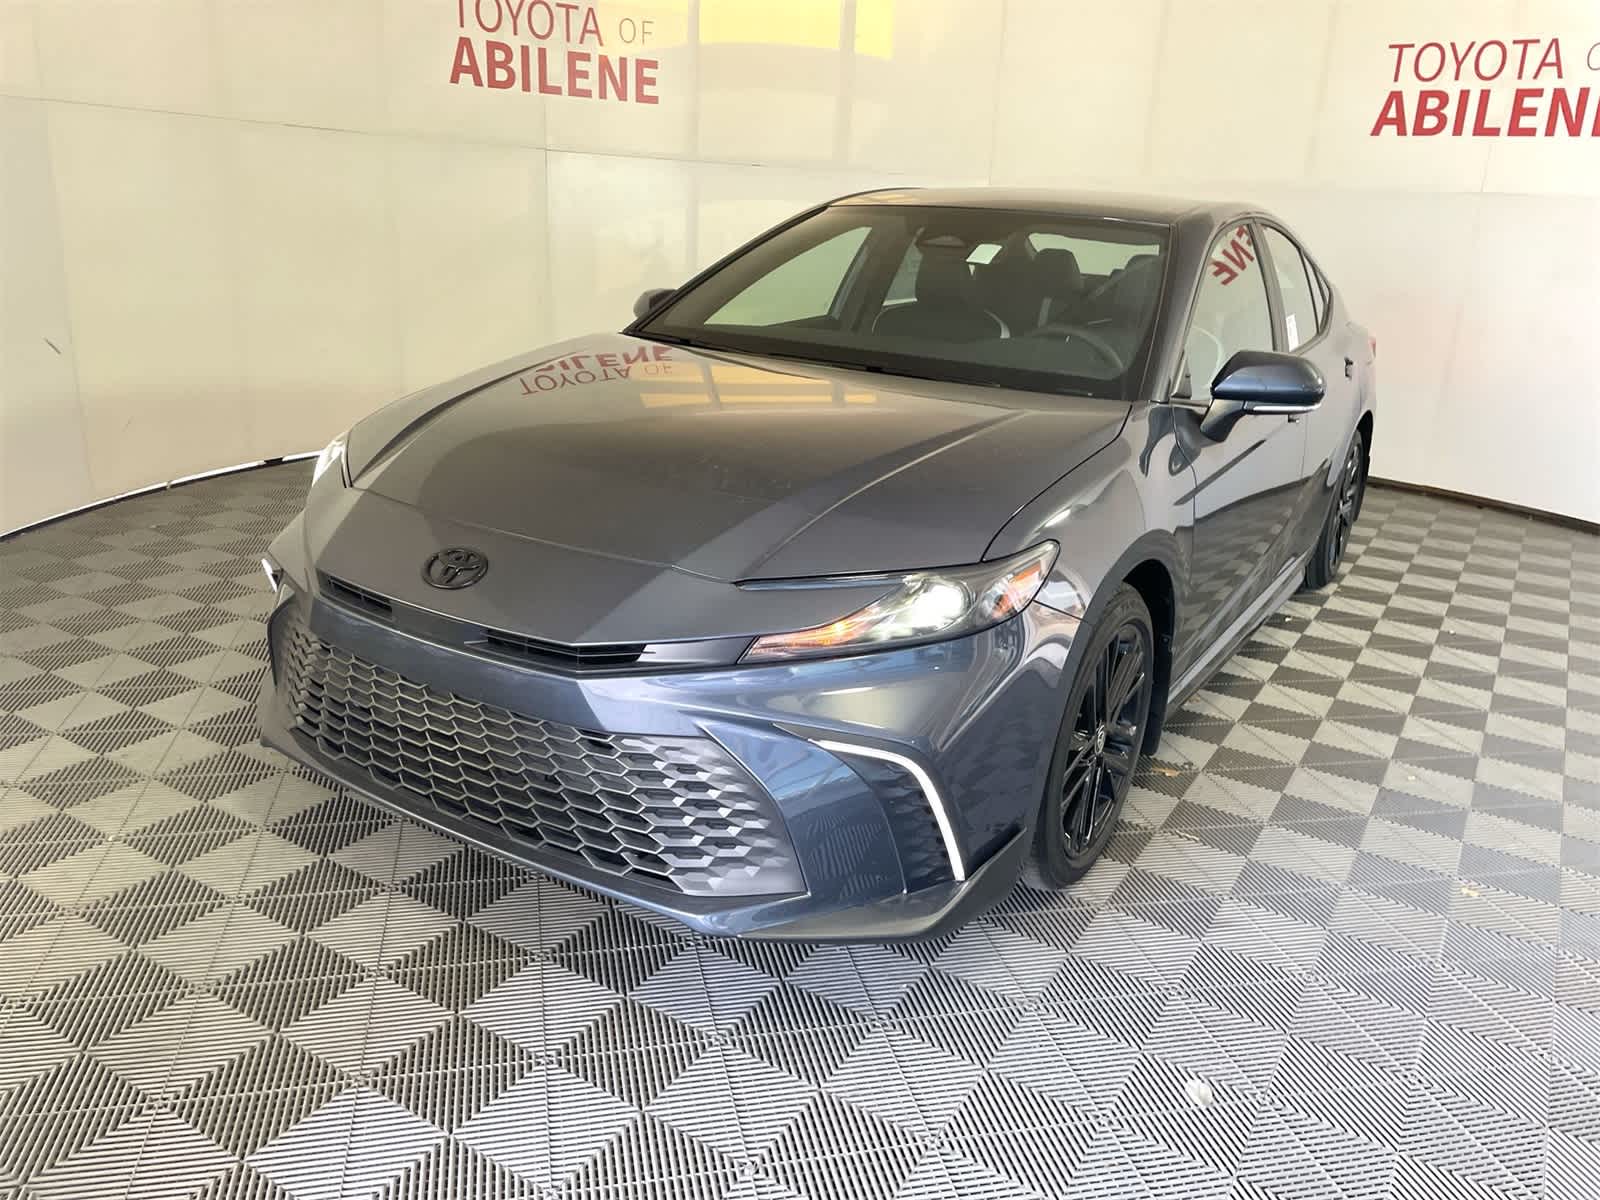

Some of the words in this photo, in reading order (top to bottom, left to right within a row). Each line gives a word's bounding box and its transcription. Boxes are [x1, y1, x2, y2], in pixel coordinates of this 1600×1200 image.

[618, 17, 655, 44] OF
[449, 36, 659, 104] ABILENE
[1388, 37, 1564, 83] TOYOTA
[1369, 86, 1600, 137] ABILEN
